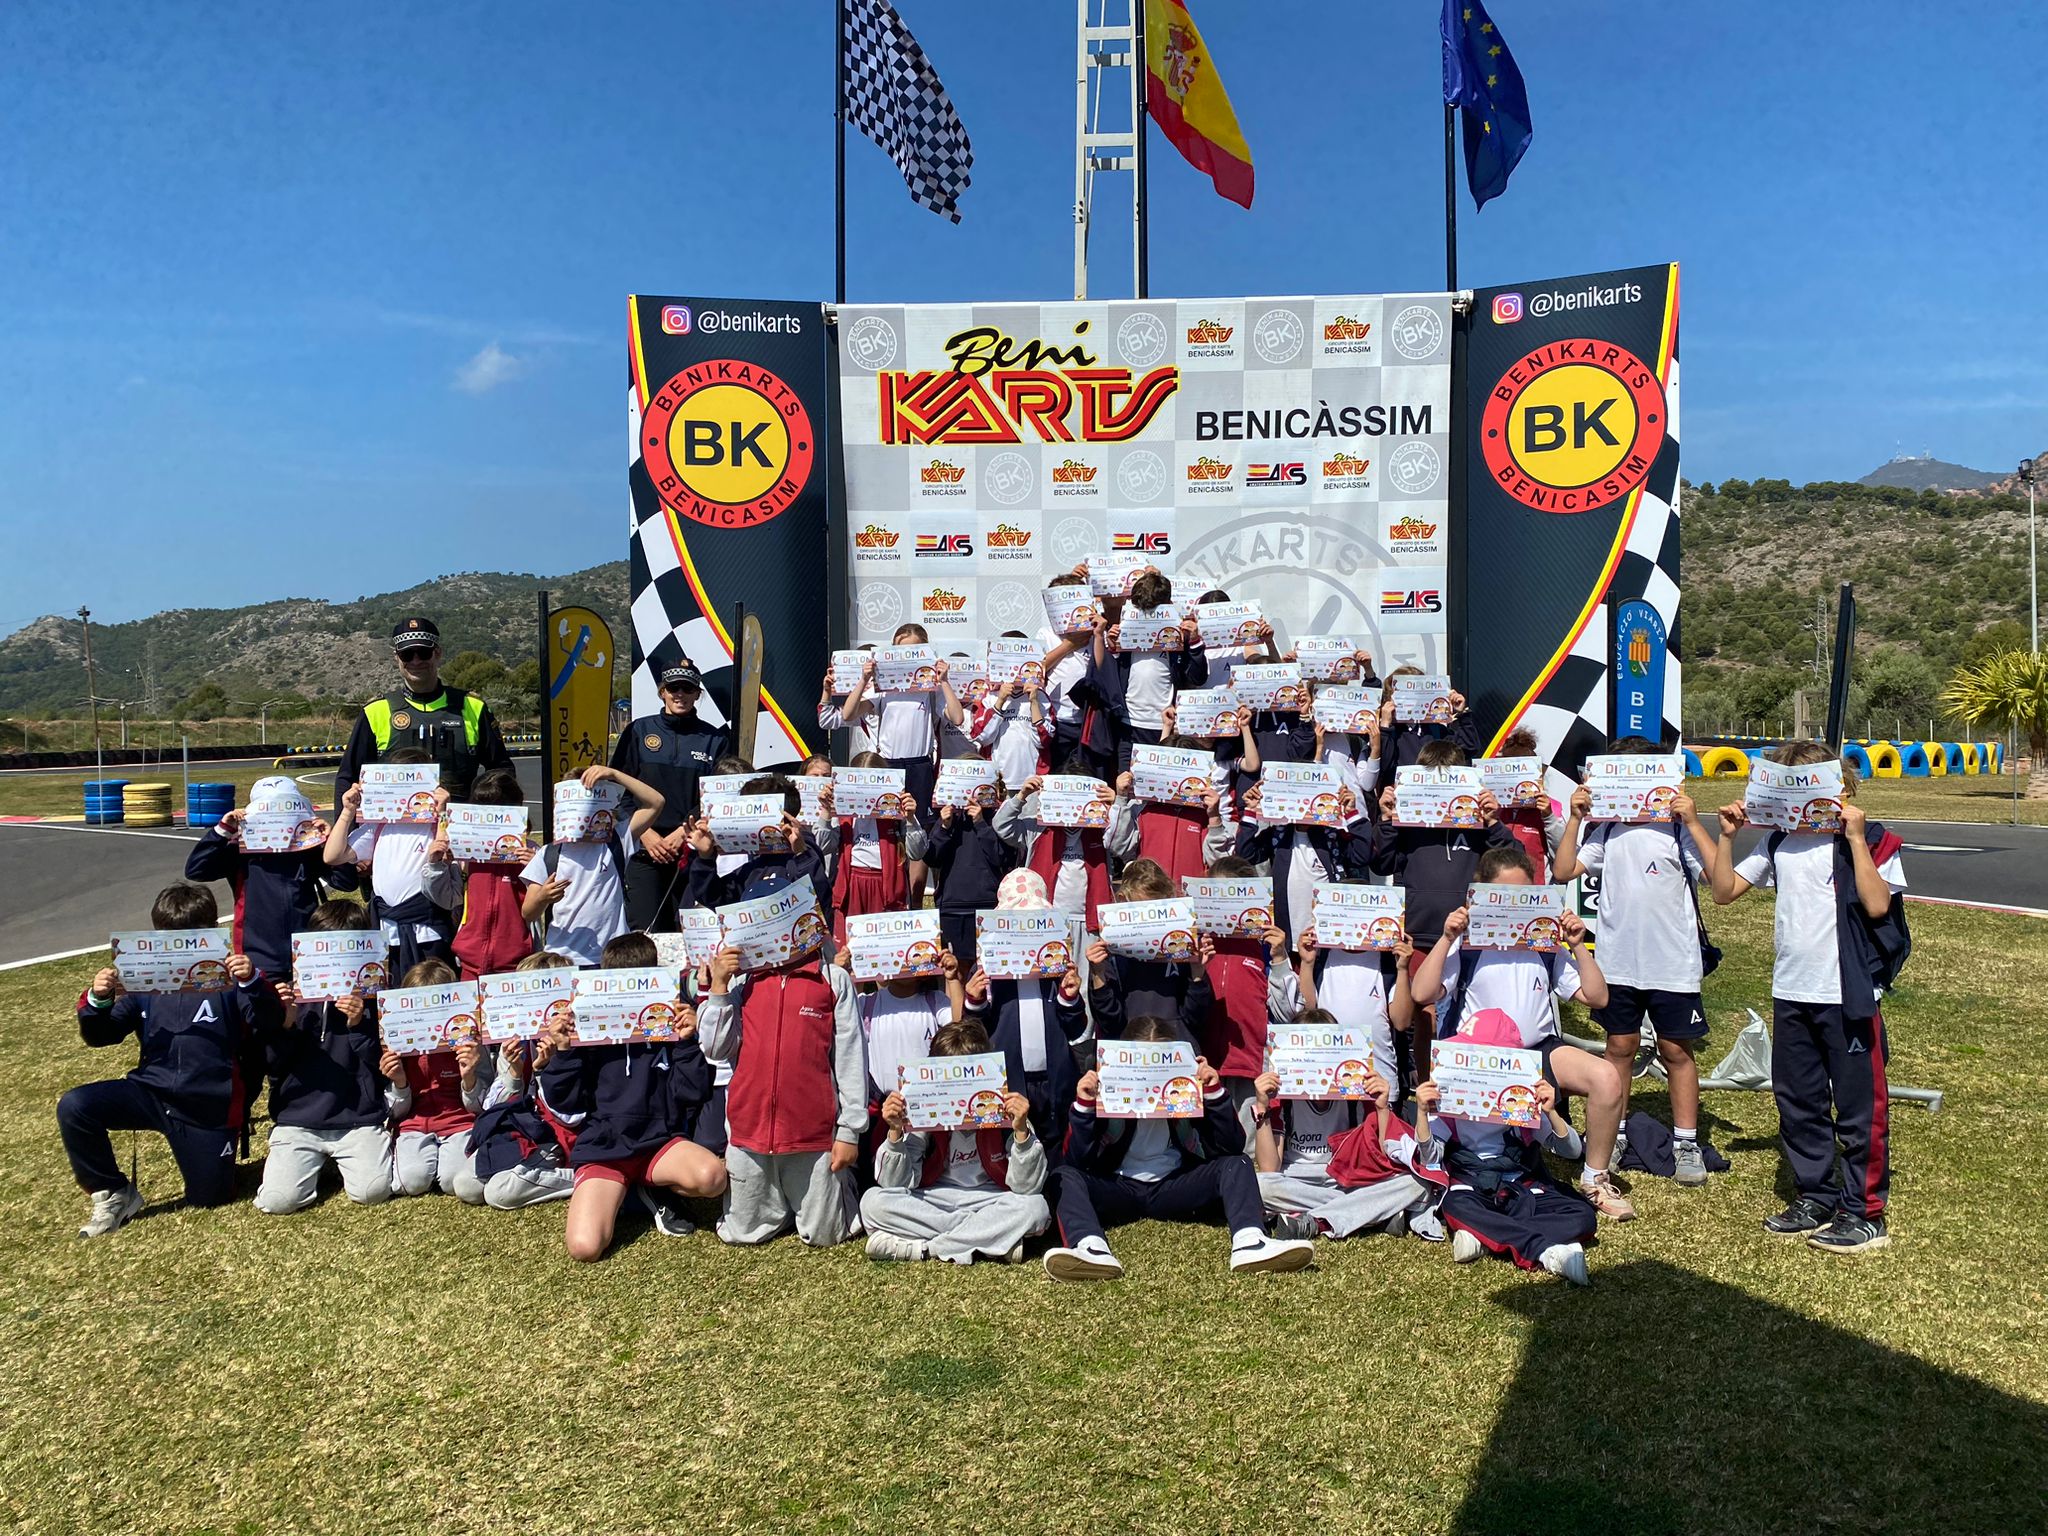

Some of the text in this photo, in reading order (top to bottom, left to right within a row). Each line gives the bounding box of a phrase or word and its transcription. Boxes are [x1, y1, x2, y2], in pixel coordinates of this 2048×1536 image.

[1529, 283, 1641, 317] @benikarts
[698, 310, 801, 334] @benikarts
[1394, 306, 1432, 331] BENIKARTS
[1127, 327, 1156, 350] BK
[1187, 327, 1233, 343] KARTS
[1263, 324, 1293, 348] BK
[1324, 324, 1370, 341] KARTS
[1401, 318, 1432, 344] BK
[857, 332, 887, 355] BK
[944, 321, 1097, 379] Beni
[1495, 342, 1649, 401] BENIKARTS
[655, 362, 800, 417] BENIKARTS
[878, 366, 1179, 445] KARTS
[1195, 400, 1432, 441] BENICÀSSIM
[1524, 398, 1621, 453] BK
[684, 420, 775, 468] BK
[1391, 442, 1428, 467] BENIKARTS
[921, 467, 965, 482] KARTS
[1052, 466, 1097, 482] KARTS
[1187, 464, 1233, 480] KARTS
[1269, 463, 1307, 486] AKS
[1323, 460, 1369, 476] KARTS
[1399, 455, 1429, 480] BK
[995, 467, 1023, 490] BK
[1498, 454, 1647, 508] BENICASIM
[658, 475, 799, 524] BENICASIM
[987, 531, 1032, 547] KARTS
[1390, 524, 1437, 539] KARTS
[856, 533, 899, 547] KARTS
[937, 535, 974, 557] AKS
[1135, 533, 1171, 555] AKS
[1097, 556, 1138, 566] DIPLOMA
[1170, 580, 1207, 590] DIPLOMA
[922, 596, 967, 611] KARTS
[1047, 591, 1081, 601] DIPLOMA
[1404, 590, 1442, 612] AKS
[863, 597, 893, 619] BK
[1129, 610, 1170, 619] DILOMA
[1208, 606, 1250, 617] DIPLOMA
[996, 643, 1034, 653] DIPLOMA
[1307, 639, 1349, 651] DIPLOMA
[884, 651, 925, 661] DIPLOMA
[1245, 669, 1288, 680] DIPLOMA
[1406, 680, 1443, 690] DIPLOMA
[1188, 694, 1227, 705] DIPLOMA
[1327, 689, 1369, 702] DIPLOMA
[1149, 752, 1198, 767] DIPLOMA
[949, 765, 986, 776] DIPLOMA
[1276, 769, 1329, 782] DIPLOMA
[1484, 763, 1528, 774] DIPLOMA
[1605, 763, 1666, 775] DIPLOMA
[375, 771, 423, 782] DIPLOMA
[847, 772, 892, 784] DIPLOMA
[1412, 772, 1467, 785] DIPLOMA
[1761, 771, 1821, 787] DIPLOMA
[562, 787, 608, 800] DIPLOMA
[1053, 780, 1098, 792] DIPLOMA
[722, 803, 769, 816] DIPLOMA
[462, 811, 511, 824] DIPLOMA
[1199, 885, 1256, 897] DIPLOMA
[1331, 891, 1388, 905] DIPLOMA
[1488, 893, 1549, 906] DIPLOMA
[738, 893, 799, 925] DIPLOMA
[1119, 907, 1177, 921] DIPLOMA
[865, 919, 923, 933] DIPLOMA
[997, 917, 1055, 931] DIPLOMA
[137, 937, 209, 951] DIPLOMA
[315, 939, 373, 952] DIPLOMA
[501, 977, 561, 993] DIPLOMA
[594, 977, 659, 992] DIPLOMA
[400, 992, 461, 1009] DIPLOMA
[1290, 1033, 1353, 1046] DIPLOMA
[1119, 1051, 1182, 1065] DIPLOMA
[1454, 1052, 1522, 1071] DIPLOMA
[920, 1064, 985, 1080] DIPLOMA
[1290, 1131, 1323, 1145] Agora
